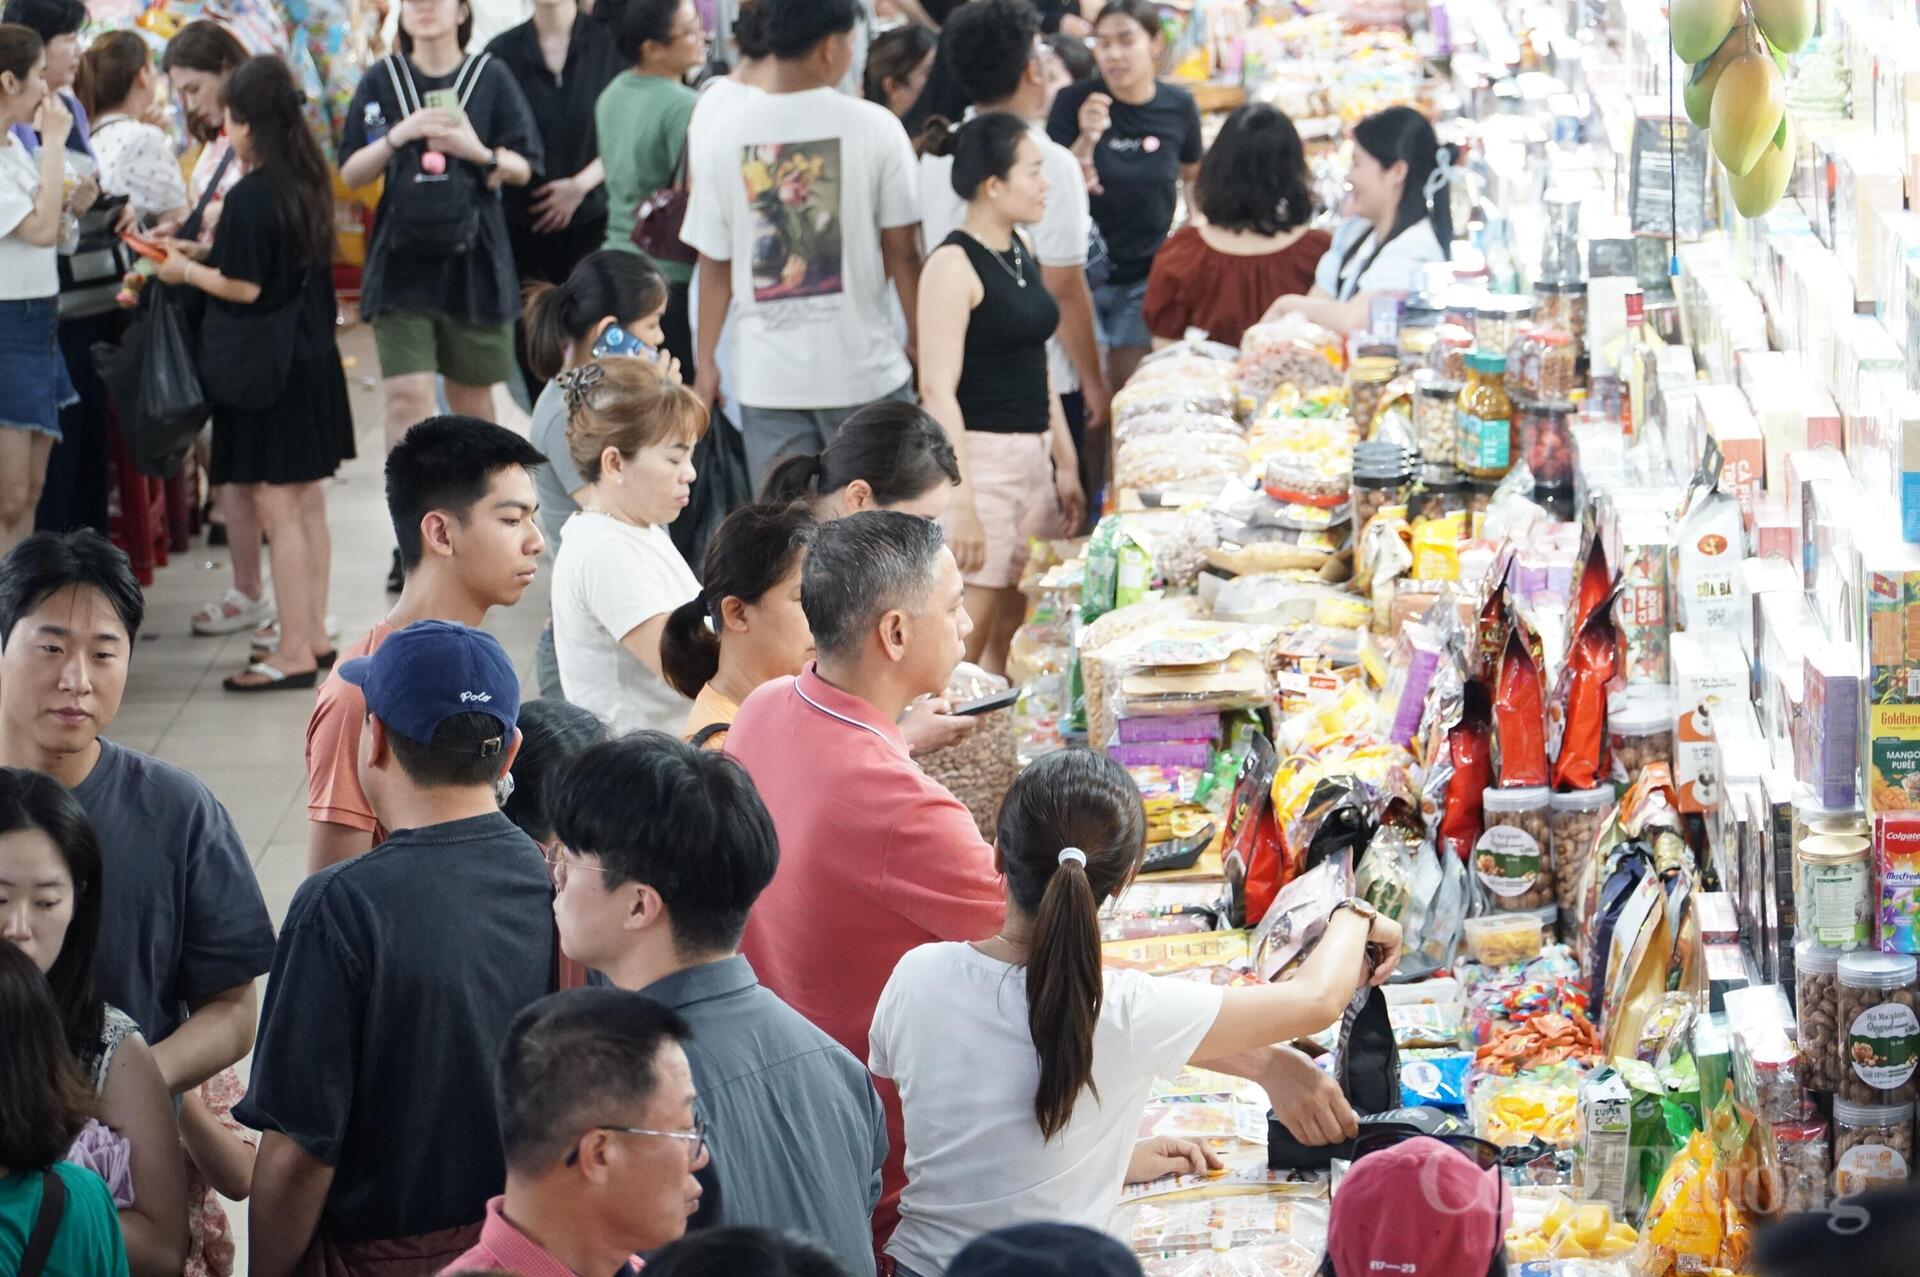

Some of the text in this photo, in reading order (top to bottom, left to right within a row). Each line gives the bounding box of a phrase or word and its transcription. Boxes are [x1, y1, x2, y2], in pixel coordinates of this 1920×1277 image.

[460, 691, 492, 702] Polo
[1887, 751, 1920, 759] MANGO
[1594, 1105, 1621, 1116] SUPER
